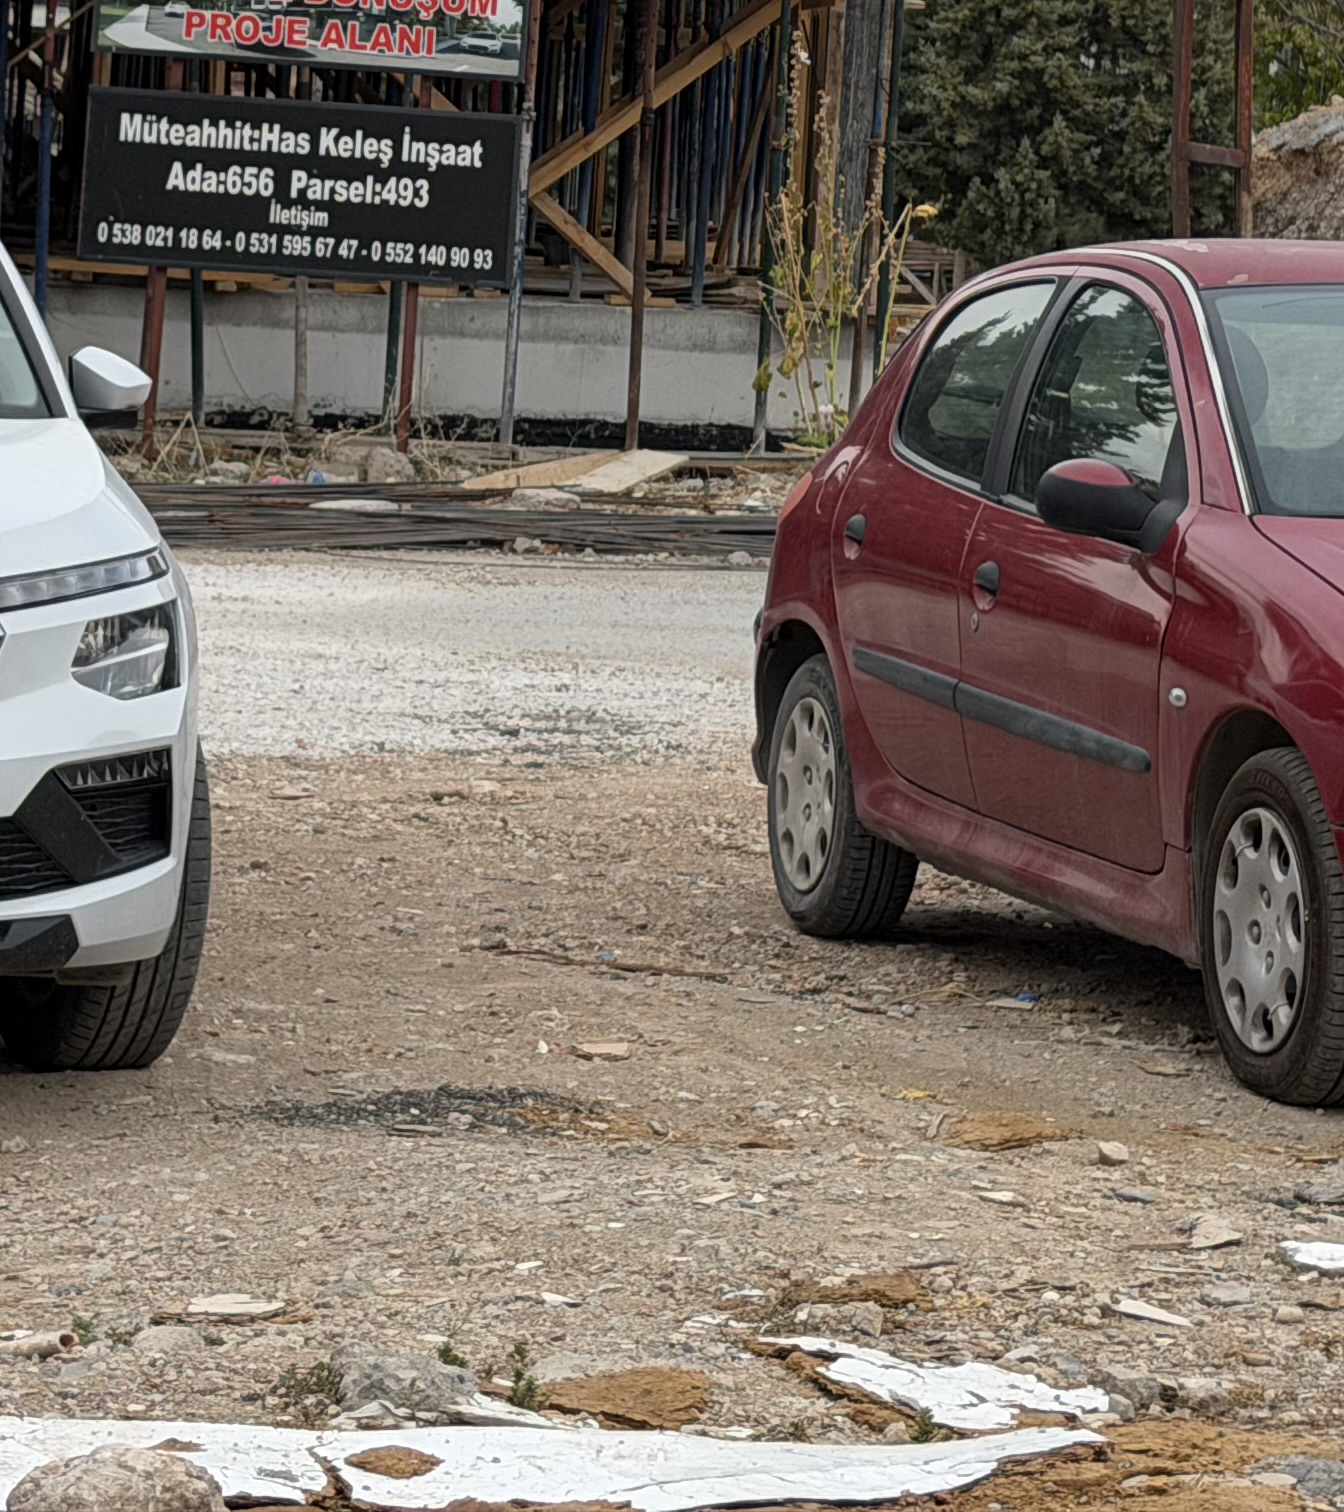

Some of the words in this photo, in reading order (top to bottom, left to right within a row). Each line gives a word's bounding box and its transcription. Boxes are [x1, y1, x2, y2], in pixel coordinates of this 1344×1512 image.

[183, 9, 310, 48] PROJE
[319, 20, 437, 58] ALANI
[318, 126, 394, 169] Keleş
[401, 126, 483, 172] İnşaat
[165, 161, 275, 197] Ada:656
[290, 169, 430, 208] Parsel:493
[269, 197, 329, 231] İletişim
[97, 221, 109, 243] 0
[112, 222, 142, 245] 538
[145, 225, 174, 247] 021
[179, 227, 199, 249] 18
[201, 228, 222, 250] 64
[235, 231, 246, 253] 0
[249, 232, 278, 254] 531
[282, 234, 312, 257] 595
[315, 236, 336, 258] 67
[337, 238, 359, 260] 47
[371, 240, 382, 262] 0
[384, 241, 415, 264] 552
[418, 244, 447, 267] 140
[450, 246, 470, 268] 90
[473, 248, 493, 270] 93
